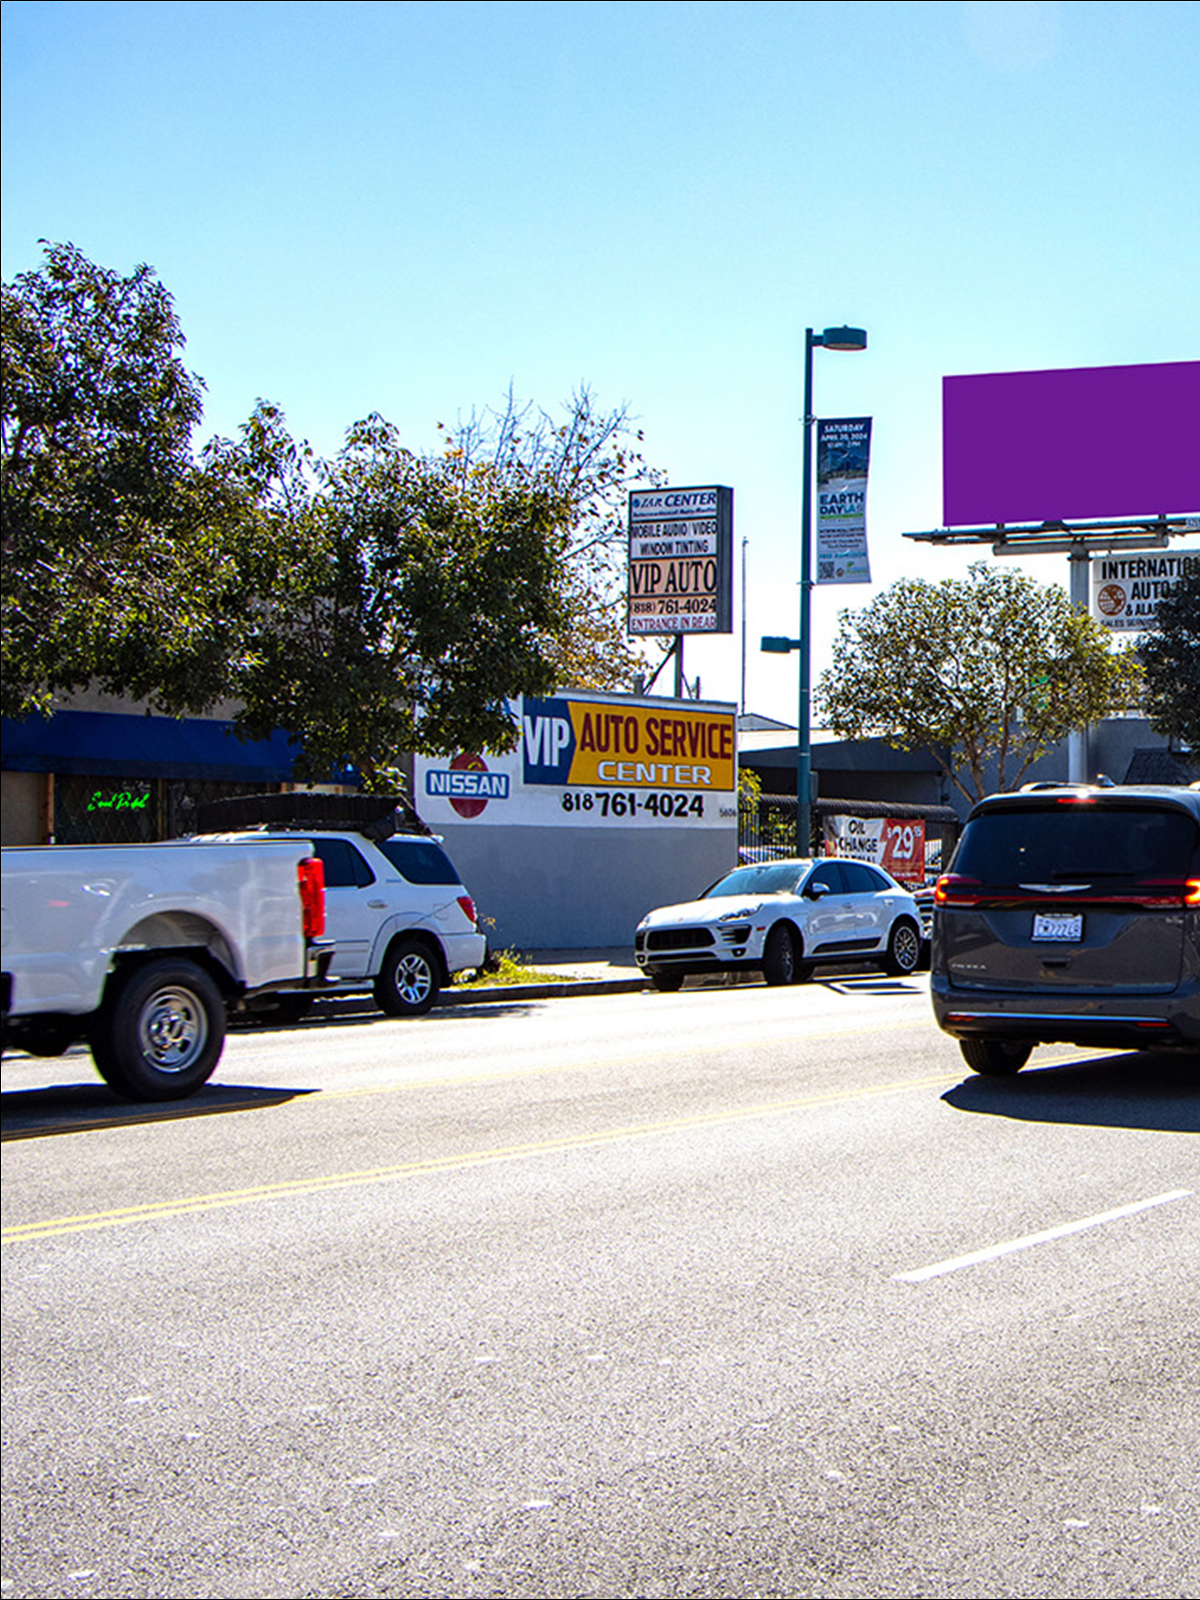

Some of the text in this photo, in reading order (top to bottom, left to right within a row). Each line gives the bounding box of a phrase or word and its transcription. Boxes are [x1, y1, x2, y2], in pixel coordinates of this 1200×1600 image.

[824, 423, 864, 433] SATURDAY
[664, 492, 717, 507] CENTER
[820, 492, 864, 504] EARTH
[631, 524, 661, 538] MOBILE
[662, 523, 688, 536] AUDIO
[692, 521, 718, 535] VIDEO
[640, 539, 709, 556] WINDOW TINTING
[631, 560, 717, 594] VIP AUTO
[1131, 580, 1171, 600] AUTO
[658, 598, 717, 615] 761-4024
[1125, 604, 1133, 617] &
[631, 616, 717, 632] ENTRANCE IN REAR
[523, 712, 733, 767] VIP AUTO SERVICE
[597, 760, 712, 785] CENTER
[429, 772, 507, 797] NISSAN
[561, 791, 704, 818] 818 761-4024
[848, 819, 866, 835] OIL
[838, 837, 878, 853] CHANGE
